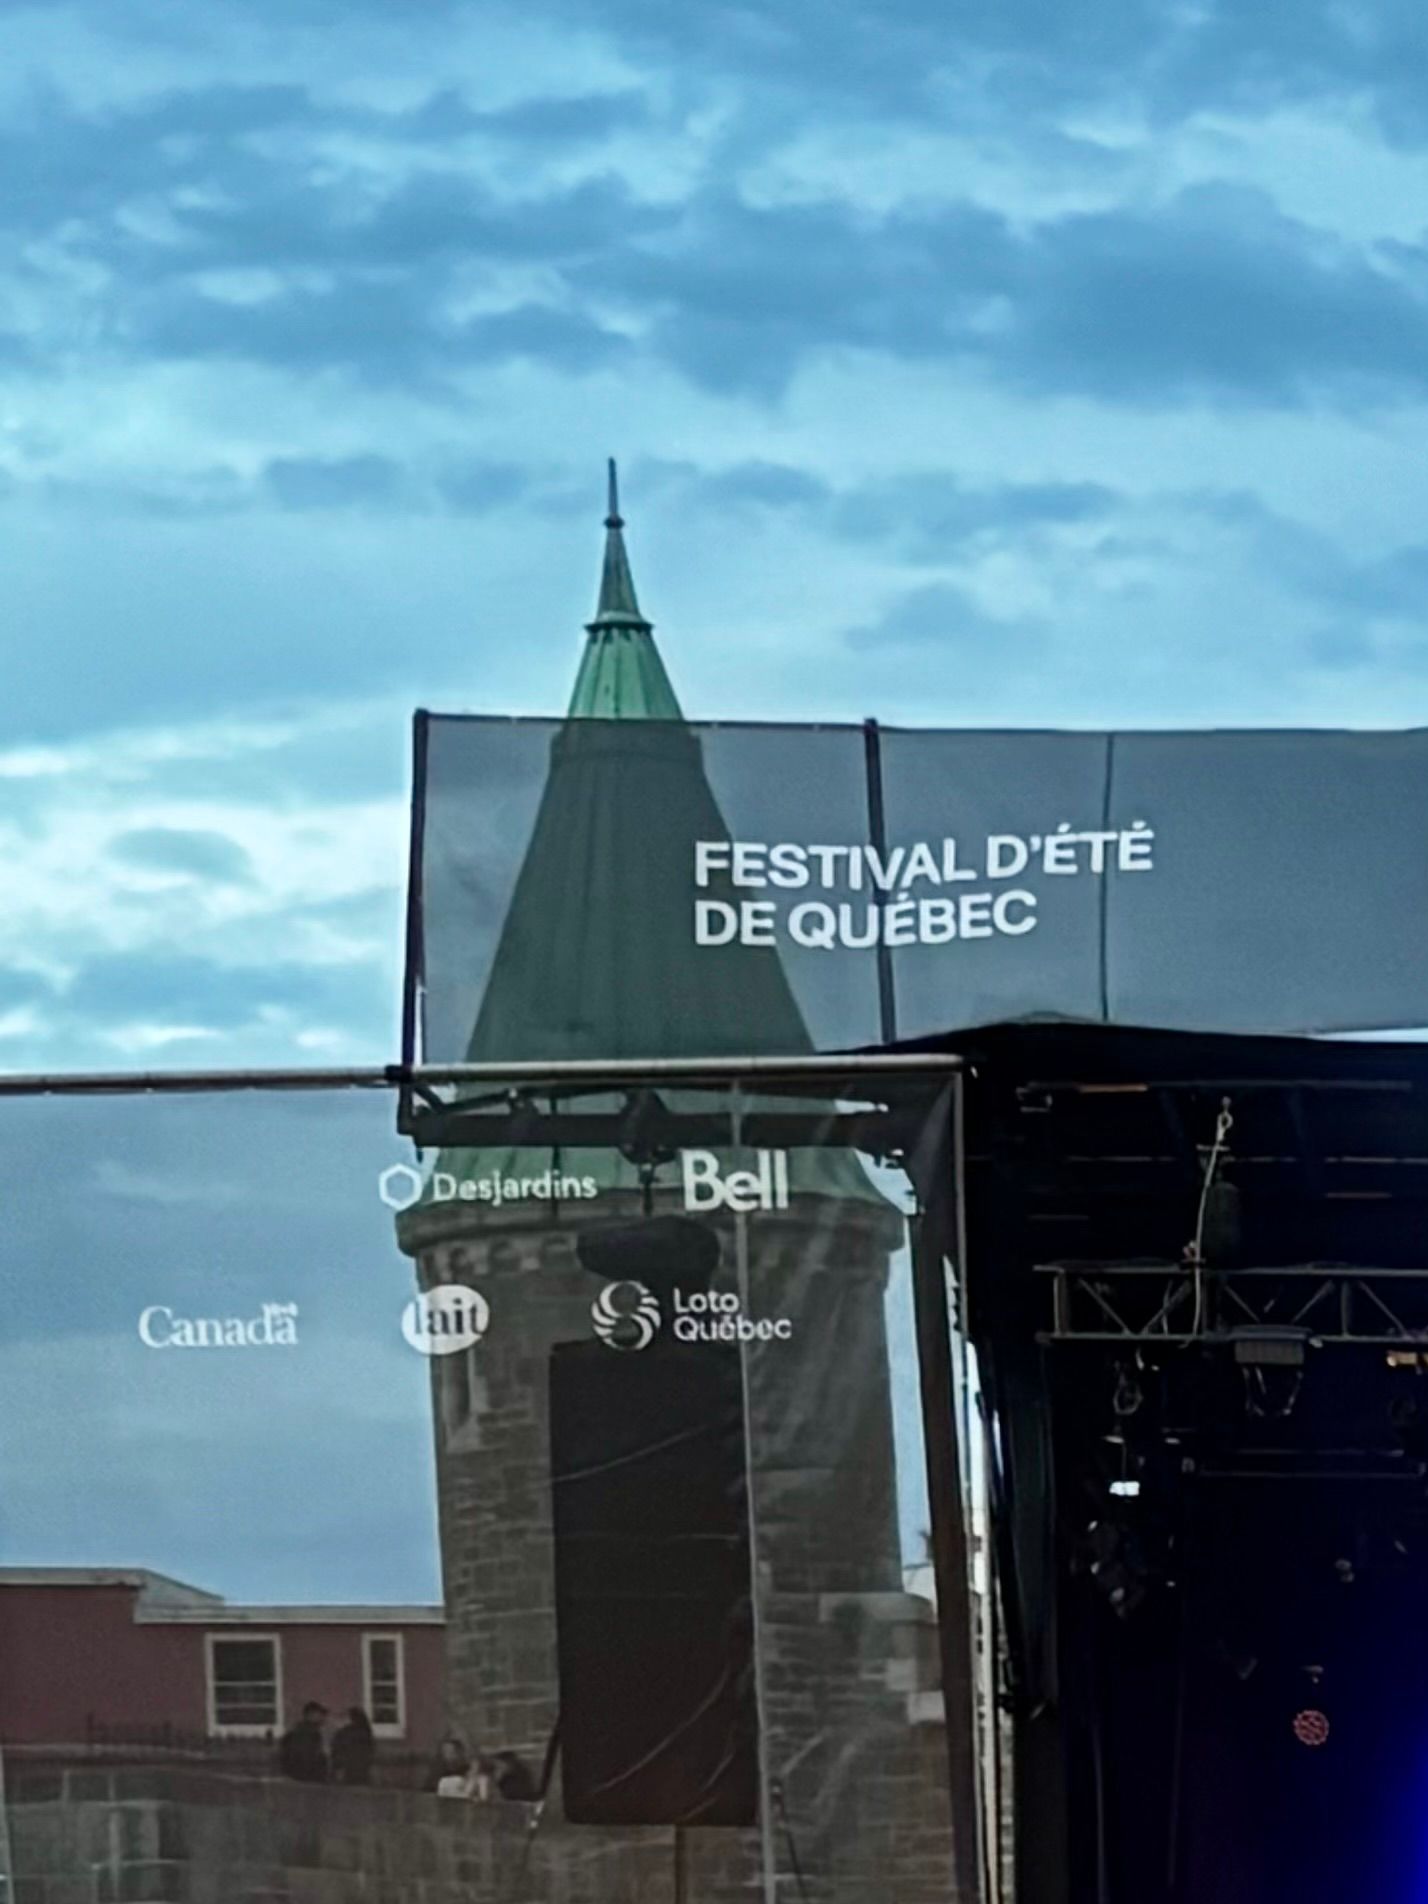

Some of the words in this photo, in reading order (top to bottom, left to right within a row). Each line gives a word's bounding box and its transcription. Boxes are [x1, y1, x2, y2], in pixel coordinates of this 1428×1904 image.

[695, 839, 977, 891] FESTIVAL
[986, 820, 1155, 880] D'ÉTÉ
[695, 899, 776, 946] DE
[787, 890, 1037, 949] QUÉBEC
[432, 1170, 598, 1206] Desjardins
[681, 1149, 788, 1212] Bell
[413, 1297, 489, 1337] lait
[672, 1287, 740, 1314] Loto
[138, 1303, 299, 1348] Canada
[672, 1313, 793, 1342] Québec
